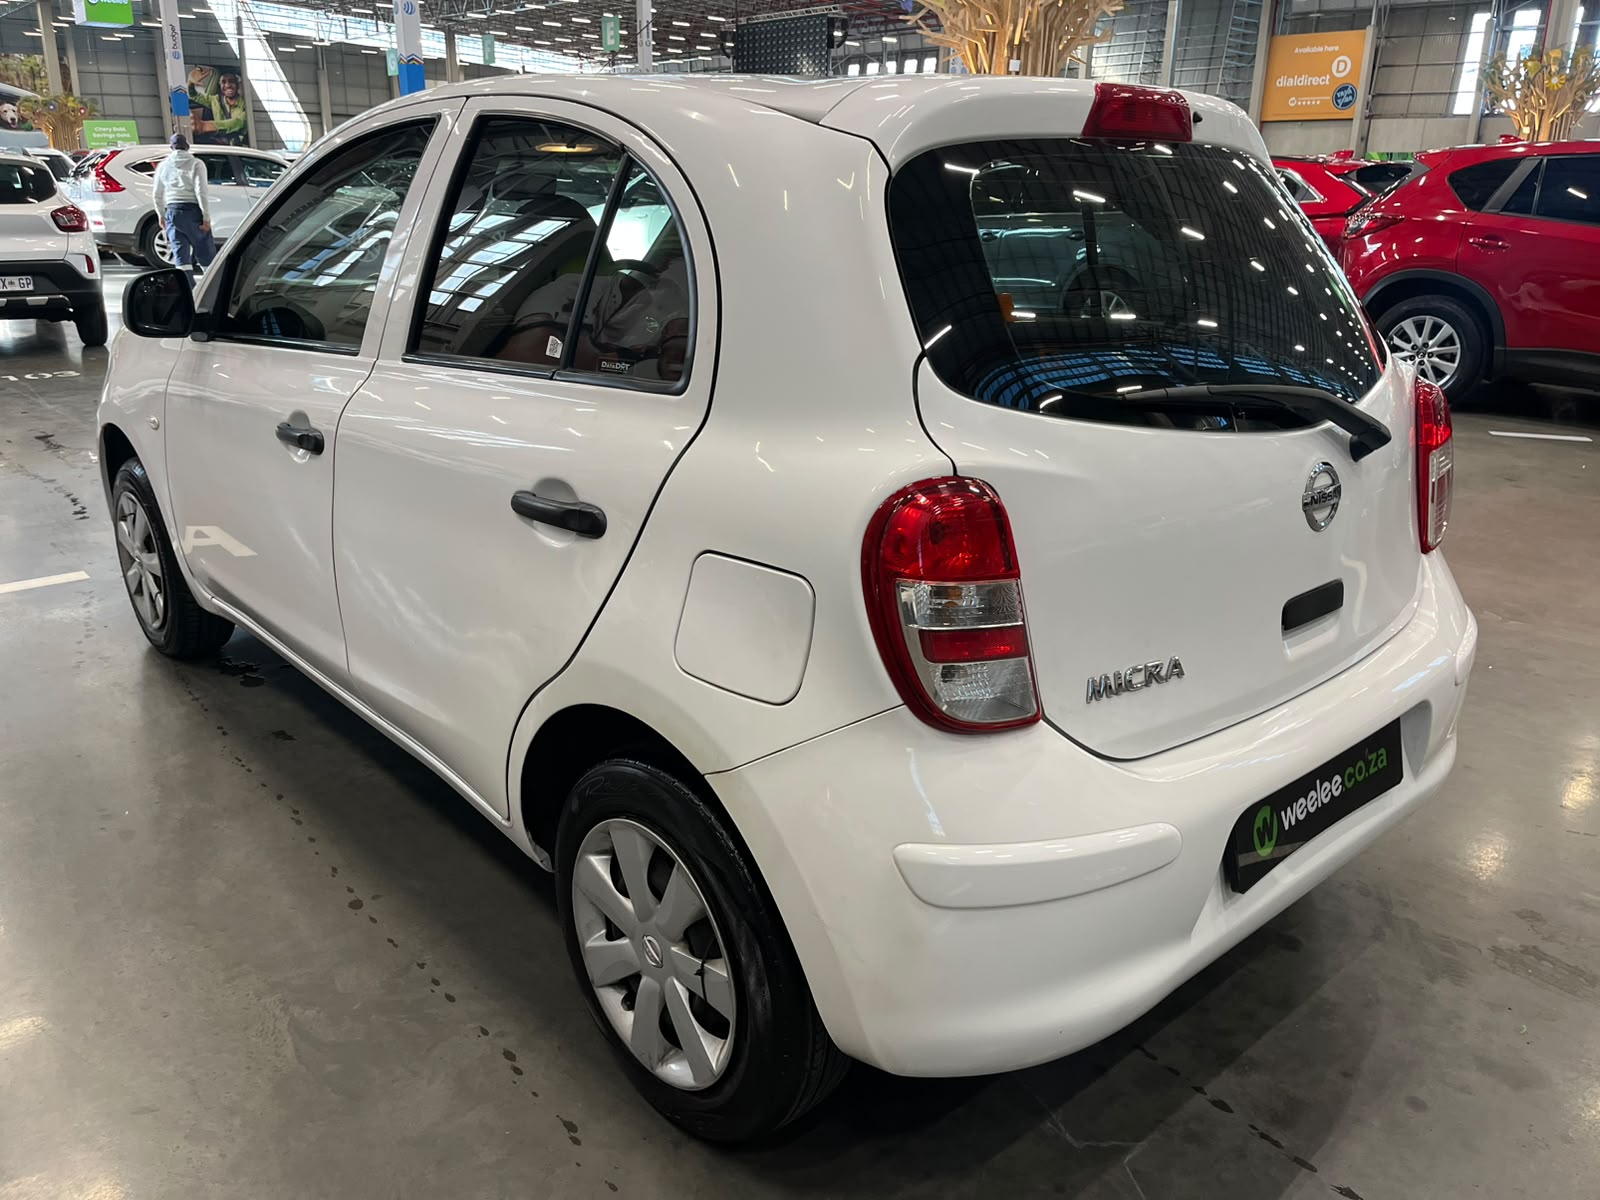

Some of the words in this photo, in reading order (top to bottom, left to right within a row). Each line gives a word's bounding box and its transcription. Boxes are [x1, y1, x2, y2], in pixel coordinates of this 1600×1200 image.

[169, 23, 178, 50] budget
[606, 21, 615, 46] E
[1294, 46, 1324, 54] Available
[1276, 74, 1331, 88] dialdirect
[18, 277, 32, 289] GP
[1, 370, 81, 382] 103
[1086, 655, 1185, 704] MICRA
[1280, 745, 1389, 831] weelee.co.za
